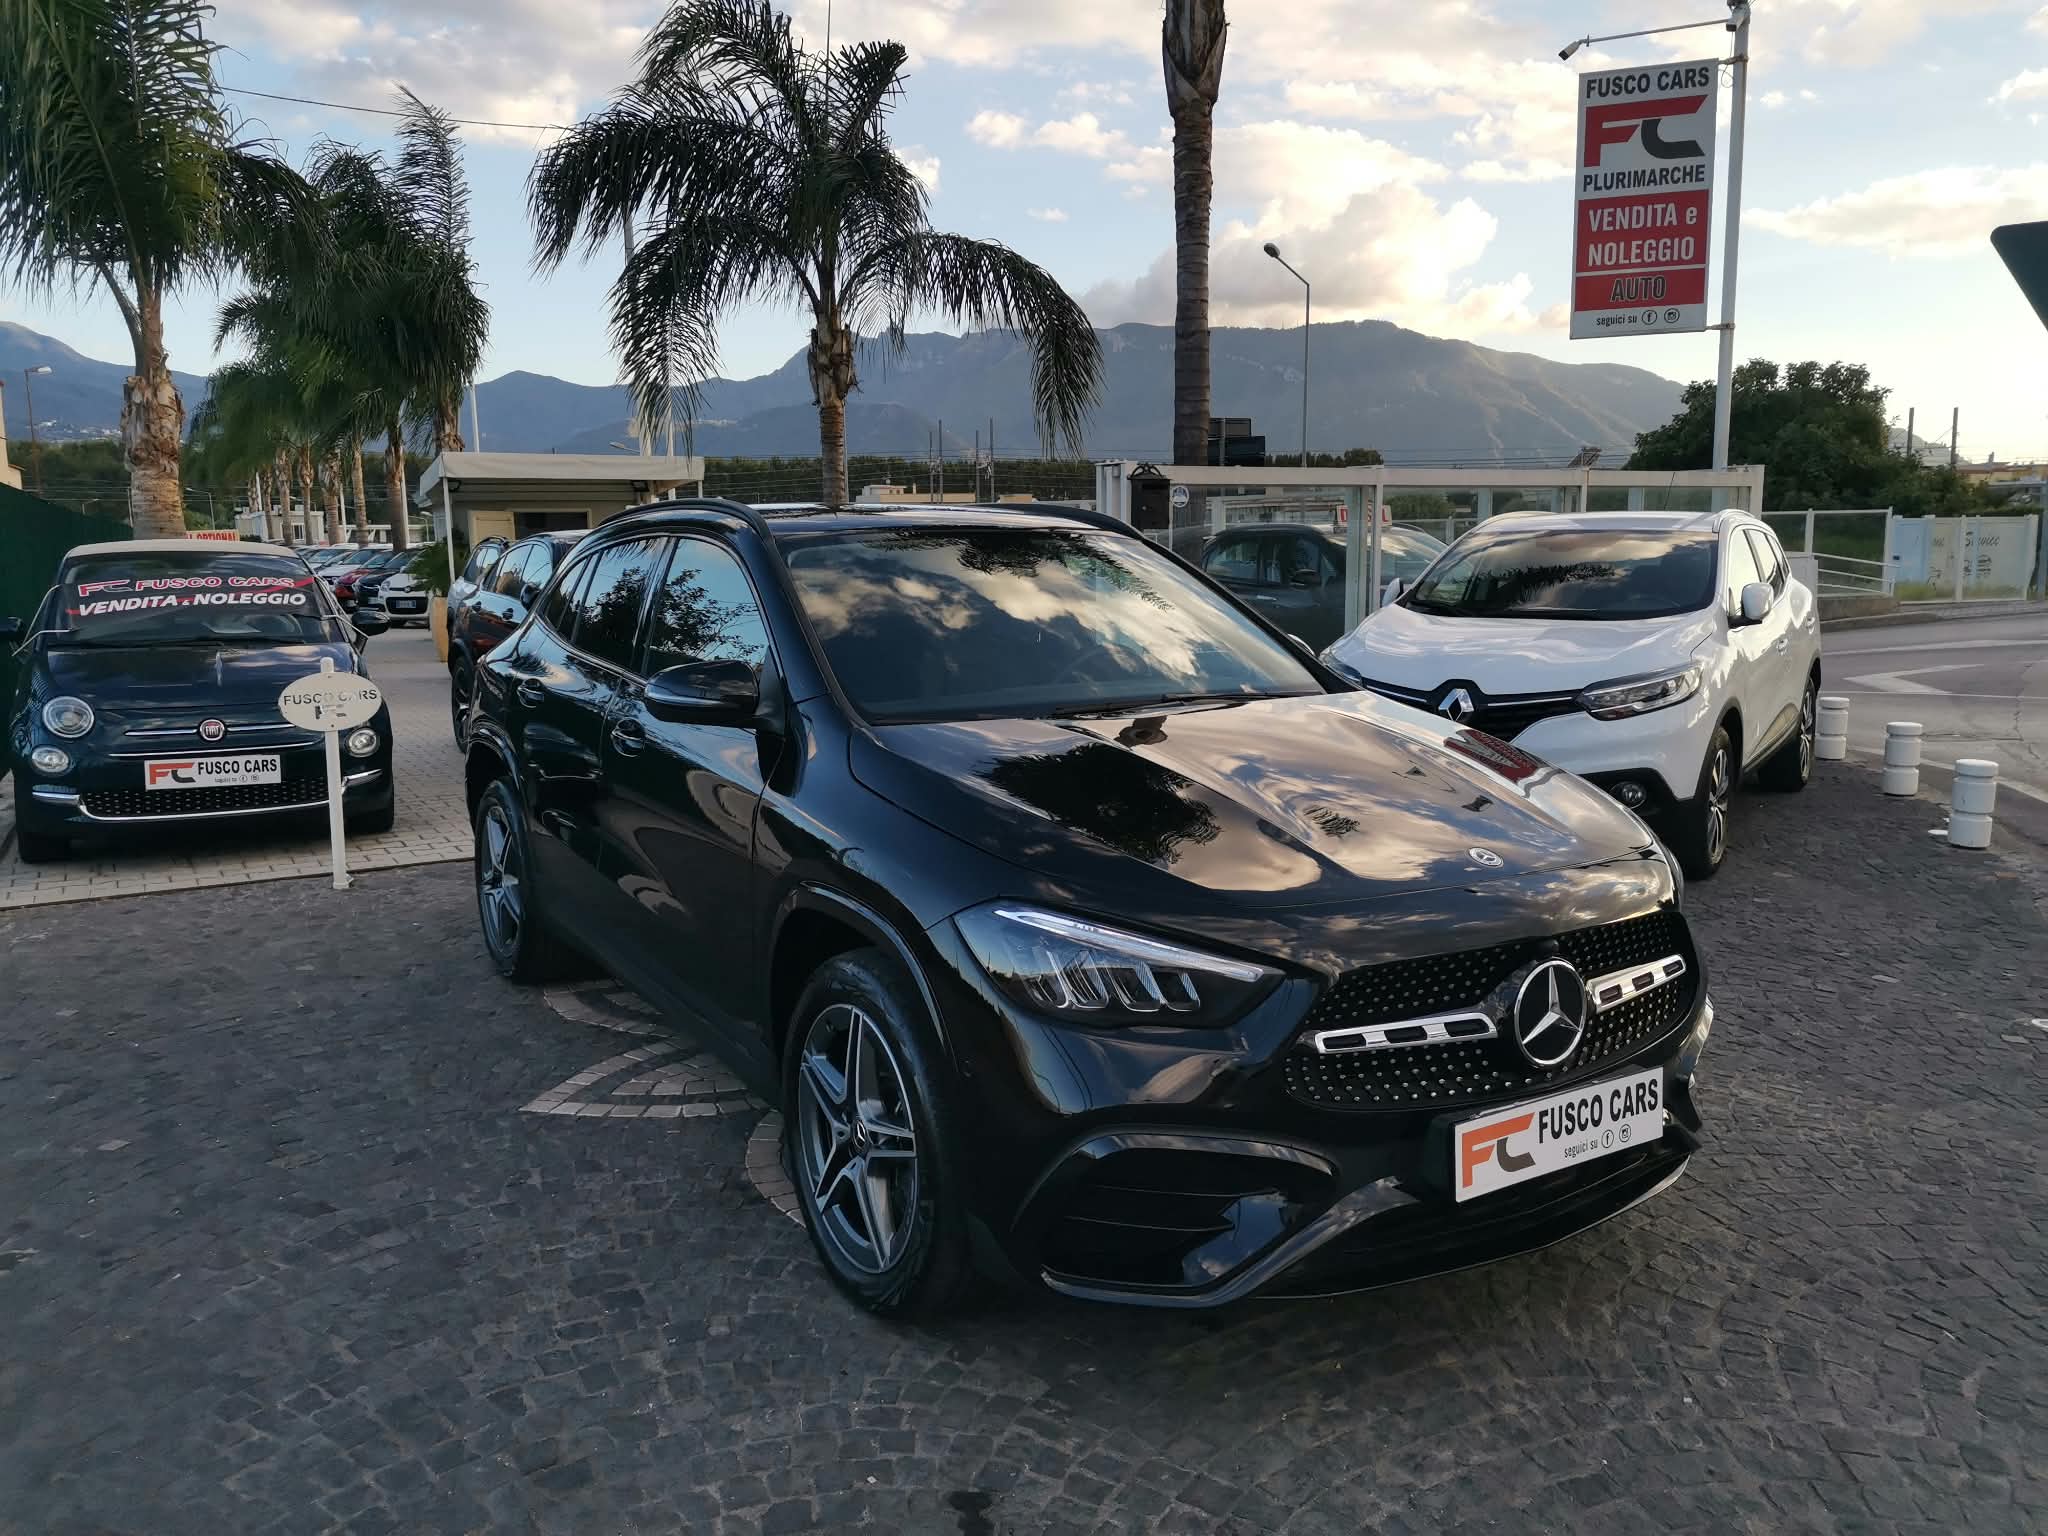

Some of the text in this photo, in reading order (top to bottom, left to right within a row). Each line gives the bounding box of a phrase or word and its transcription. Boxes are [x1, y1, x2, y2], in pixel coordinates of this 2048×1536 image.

[1586, 66, 1710, 99] FUSCO CARS
[1583, 164, 1705, 192] PLURIMARCHE
[1588, 202, 1698, 232] VENDITA e
[1587, 236, 1695, 267] NOLEGGIO
[1610, 275, 1667, 303] AUTO
[1596, 314, 1638, 327] seguici su
[135, 576, 223, 591] FUSCO
[228, 576, 296, 588] CARS
[79, 594, 179, 616] VENDITA
[192, 592, 307, 606] NOLEGGIO
[197, 760, 240, 775] FUSCO
[244, 759, 277, 773] CARS
[1538, 1094, 1603, 1144] FUSCO
[1609, 1078, 1658, 1122] CARS
[1564, 1139, 1598, 1158] seguici su
